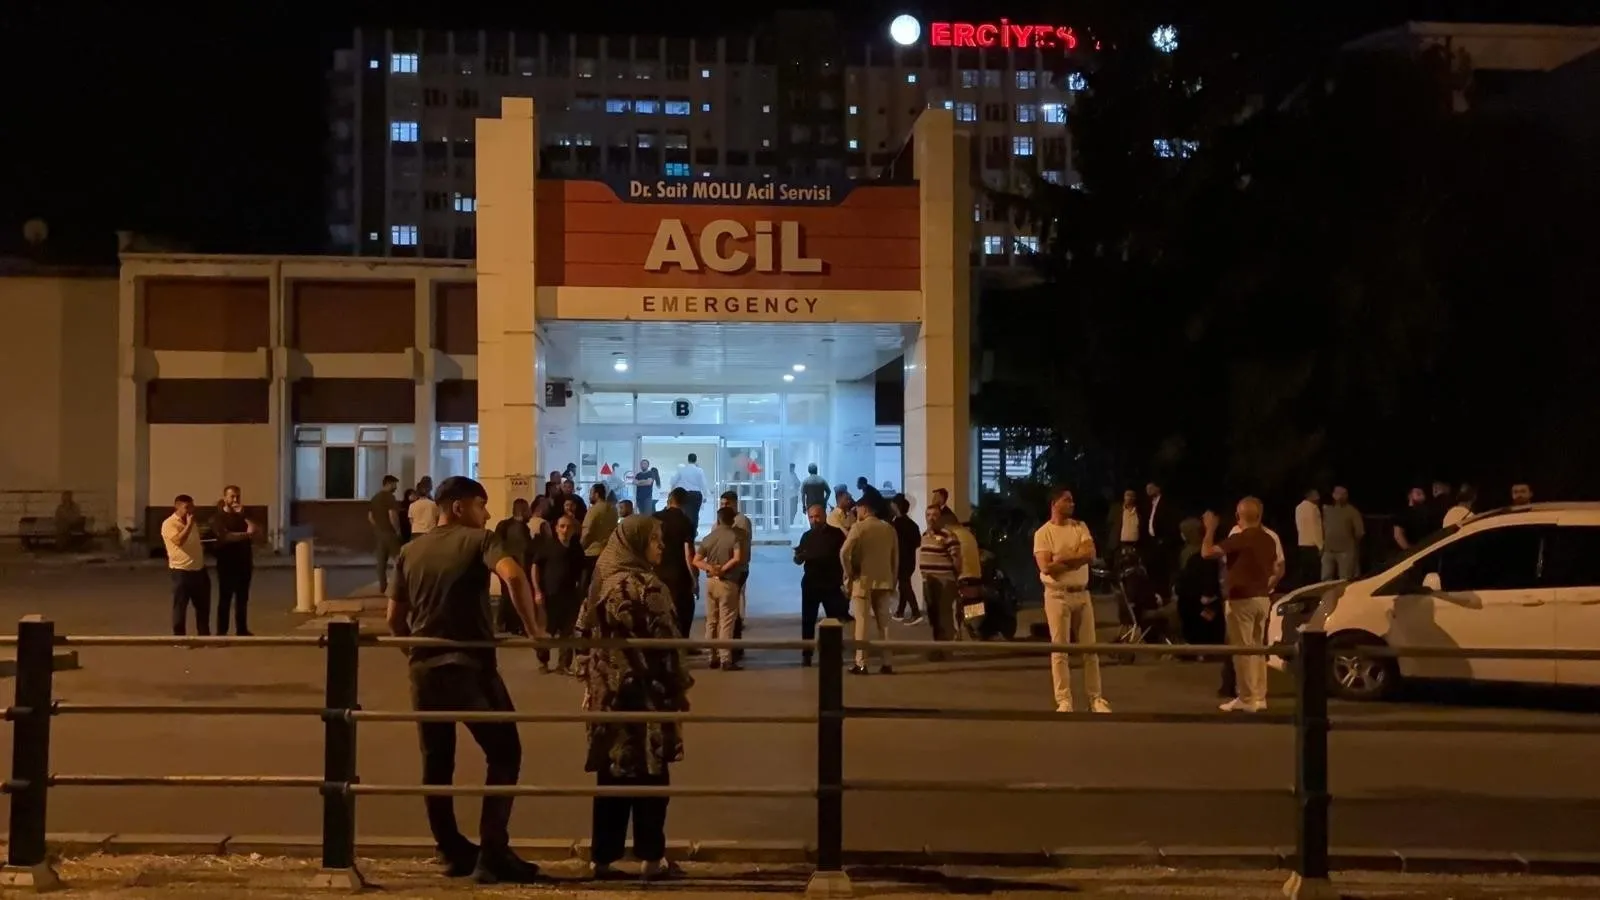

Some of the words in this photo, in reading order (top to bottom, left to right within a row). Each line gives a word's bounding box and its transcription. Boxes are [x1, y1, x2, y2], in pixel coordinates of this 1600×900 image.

[630, 180, 652, 198] Dr.
[657, 181, 688, 199] Sait
[692, 182, 742, 199] MOLU
[746, 183, 775, 200] Acil
[779, 184, 831, 201] Servisi
[642, 295, 819, 313] EMERGENCY
[676, 401, 690, 416] B
